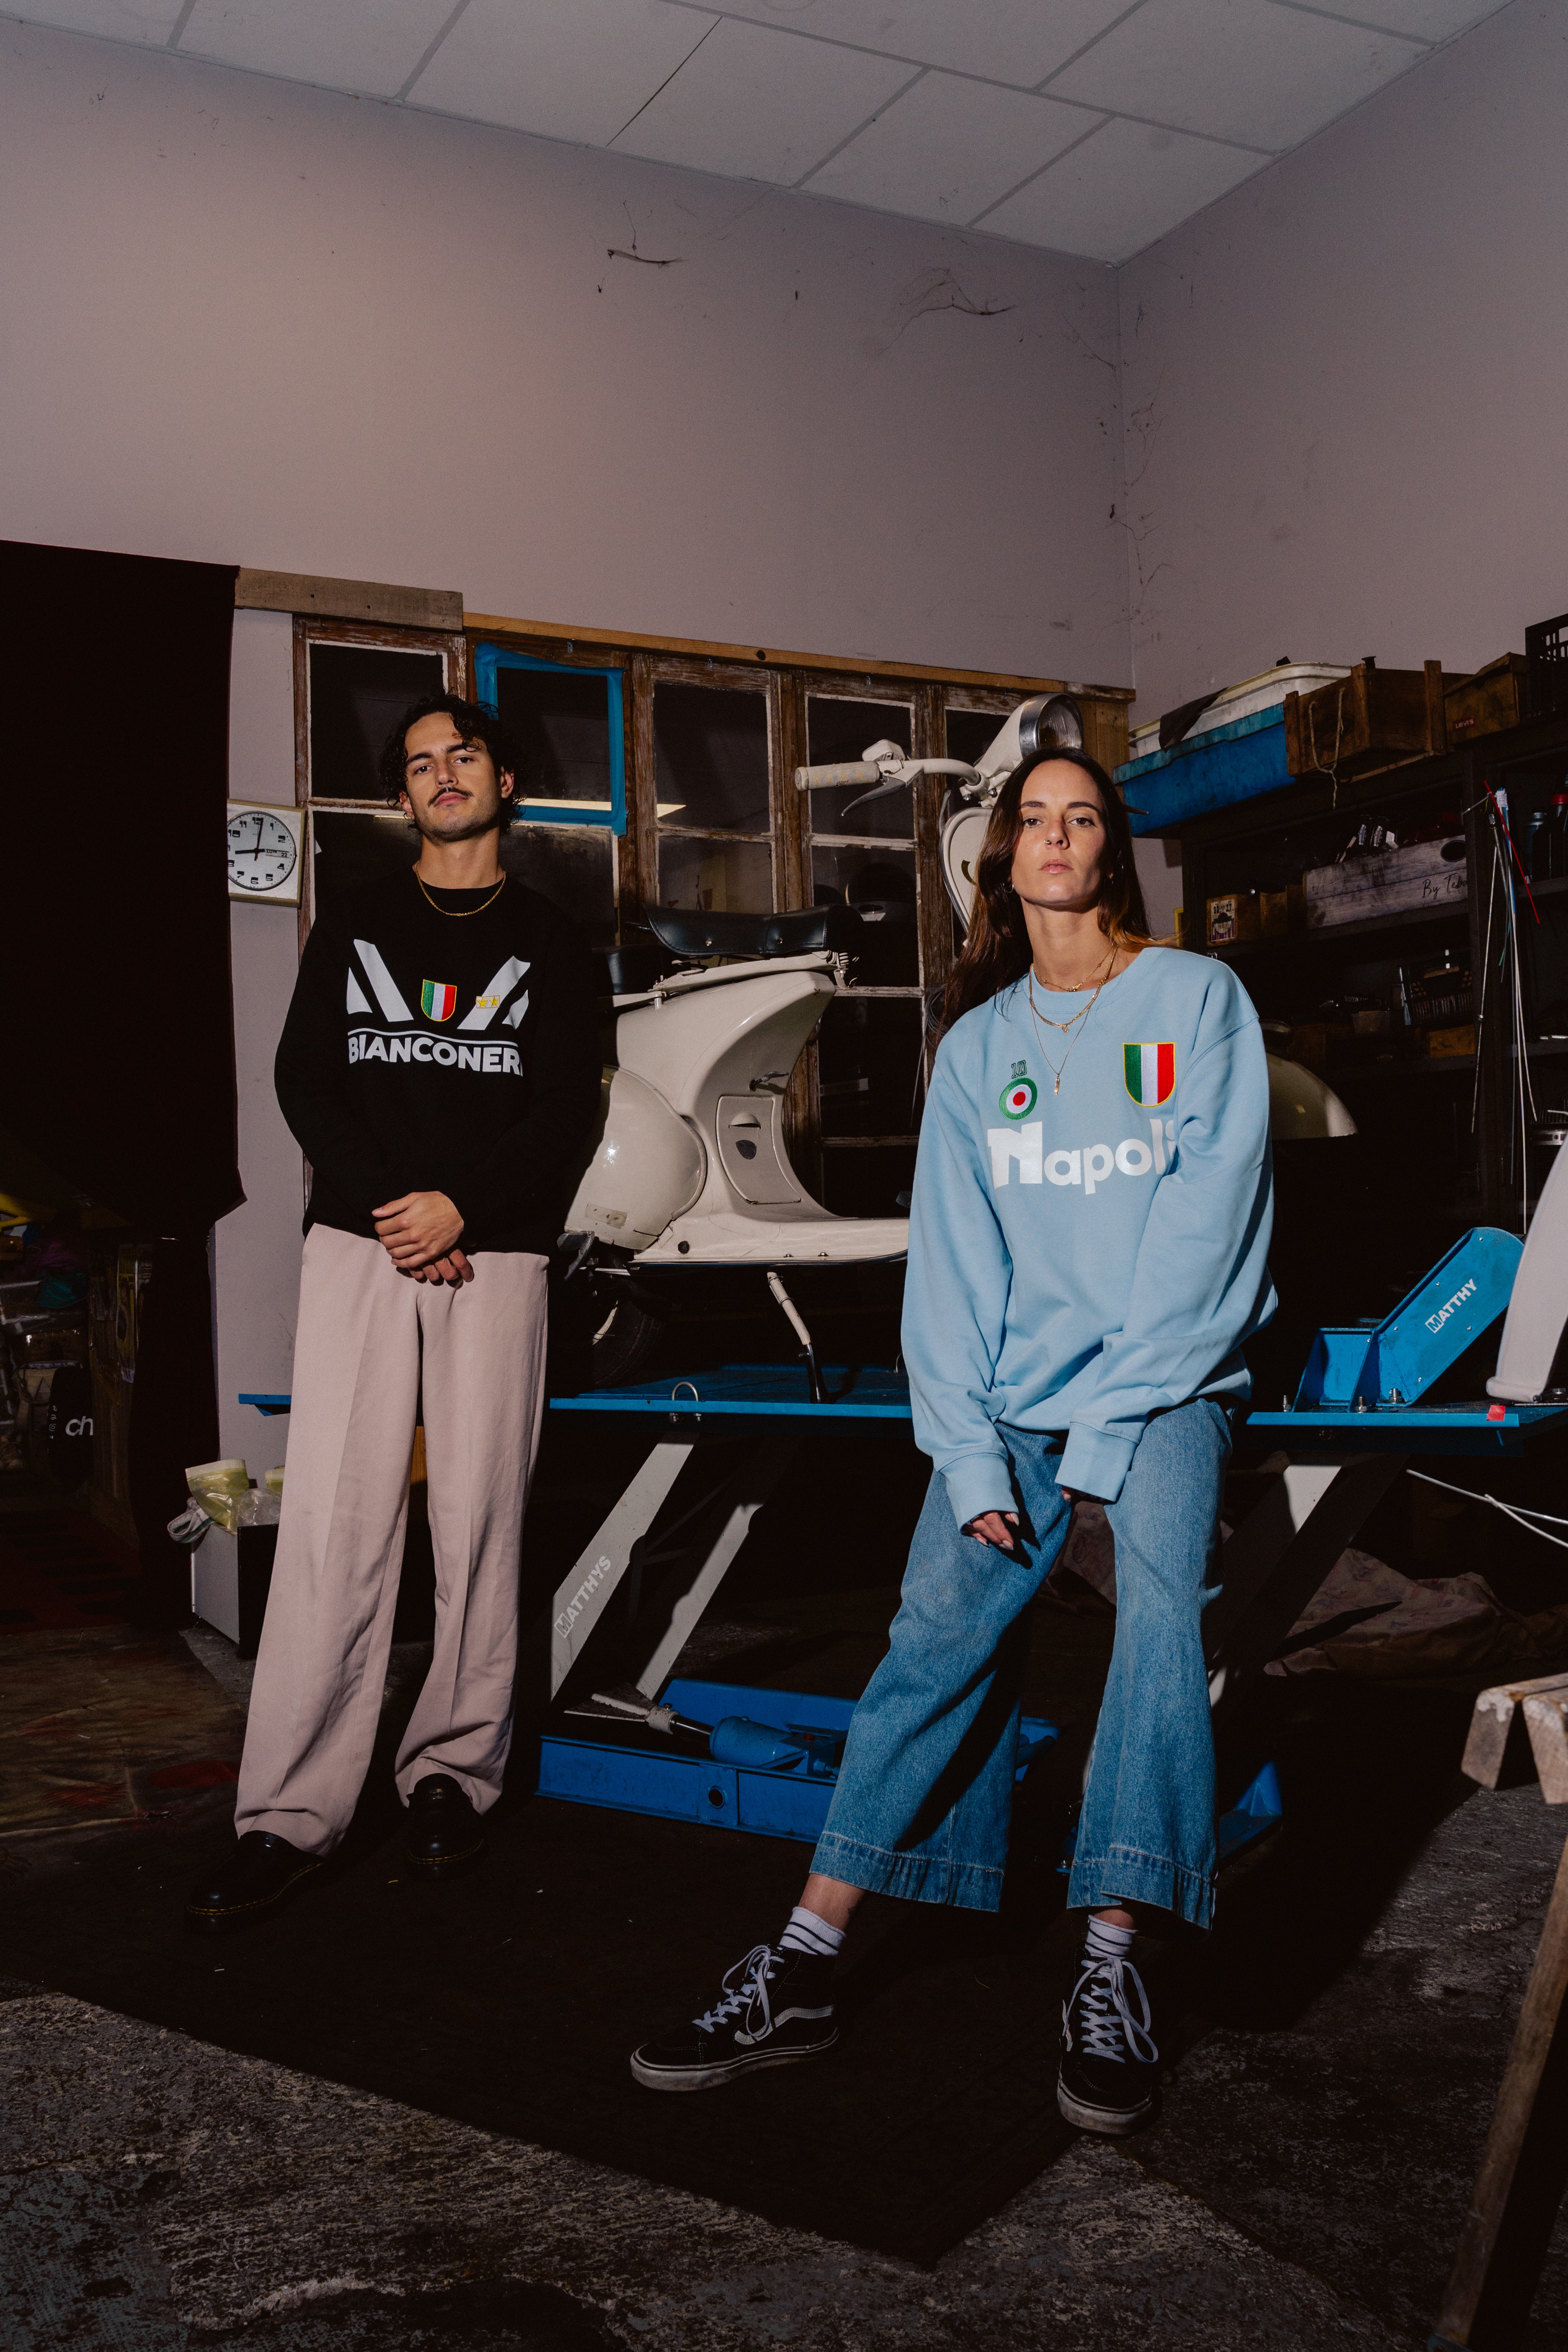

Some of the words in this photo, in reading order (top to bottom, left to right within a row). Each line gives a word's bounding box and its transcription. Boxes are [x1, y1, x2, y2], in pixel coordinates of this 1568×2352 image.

[270, 823, 274, 831] 1
[278, 835, 286, 843] 2
[1422, 879, 1441, 900] By
[1011, 1060, 1027, 1079] 10
[987, 1118, 1176, 1195] Napoli
[1425, 1278, 1477, 1334] MATTHY
[554, 1555, 611, 1638] MATTHYS
